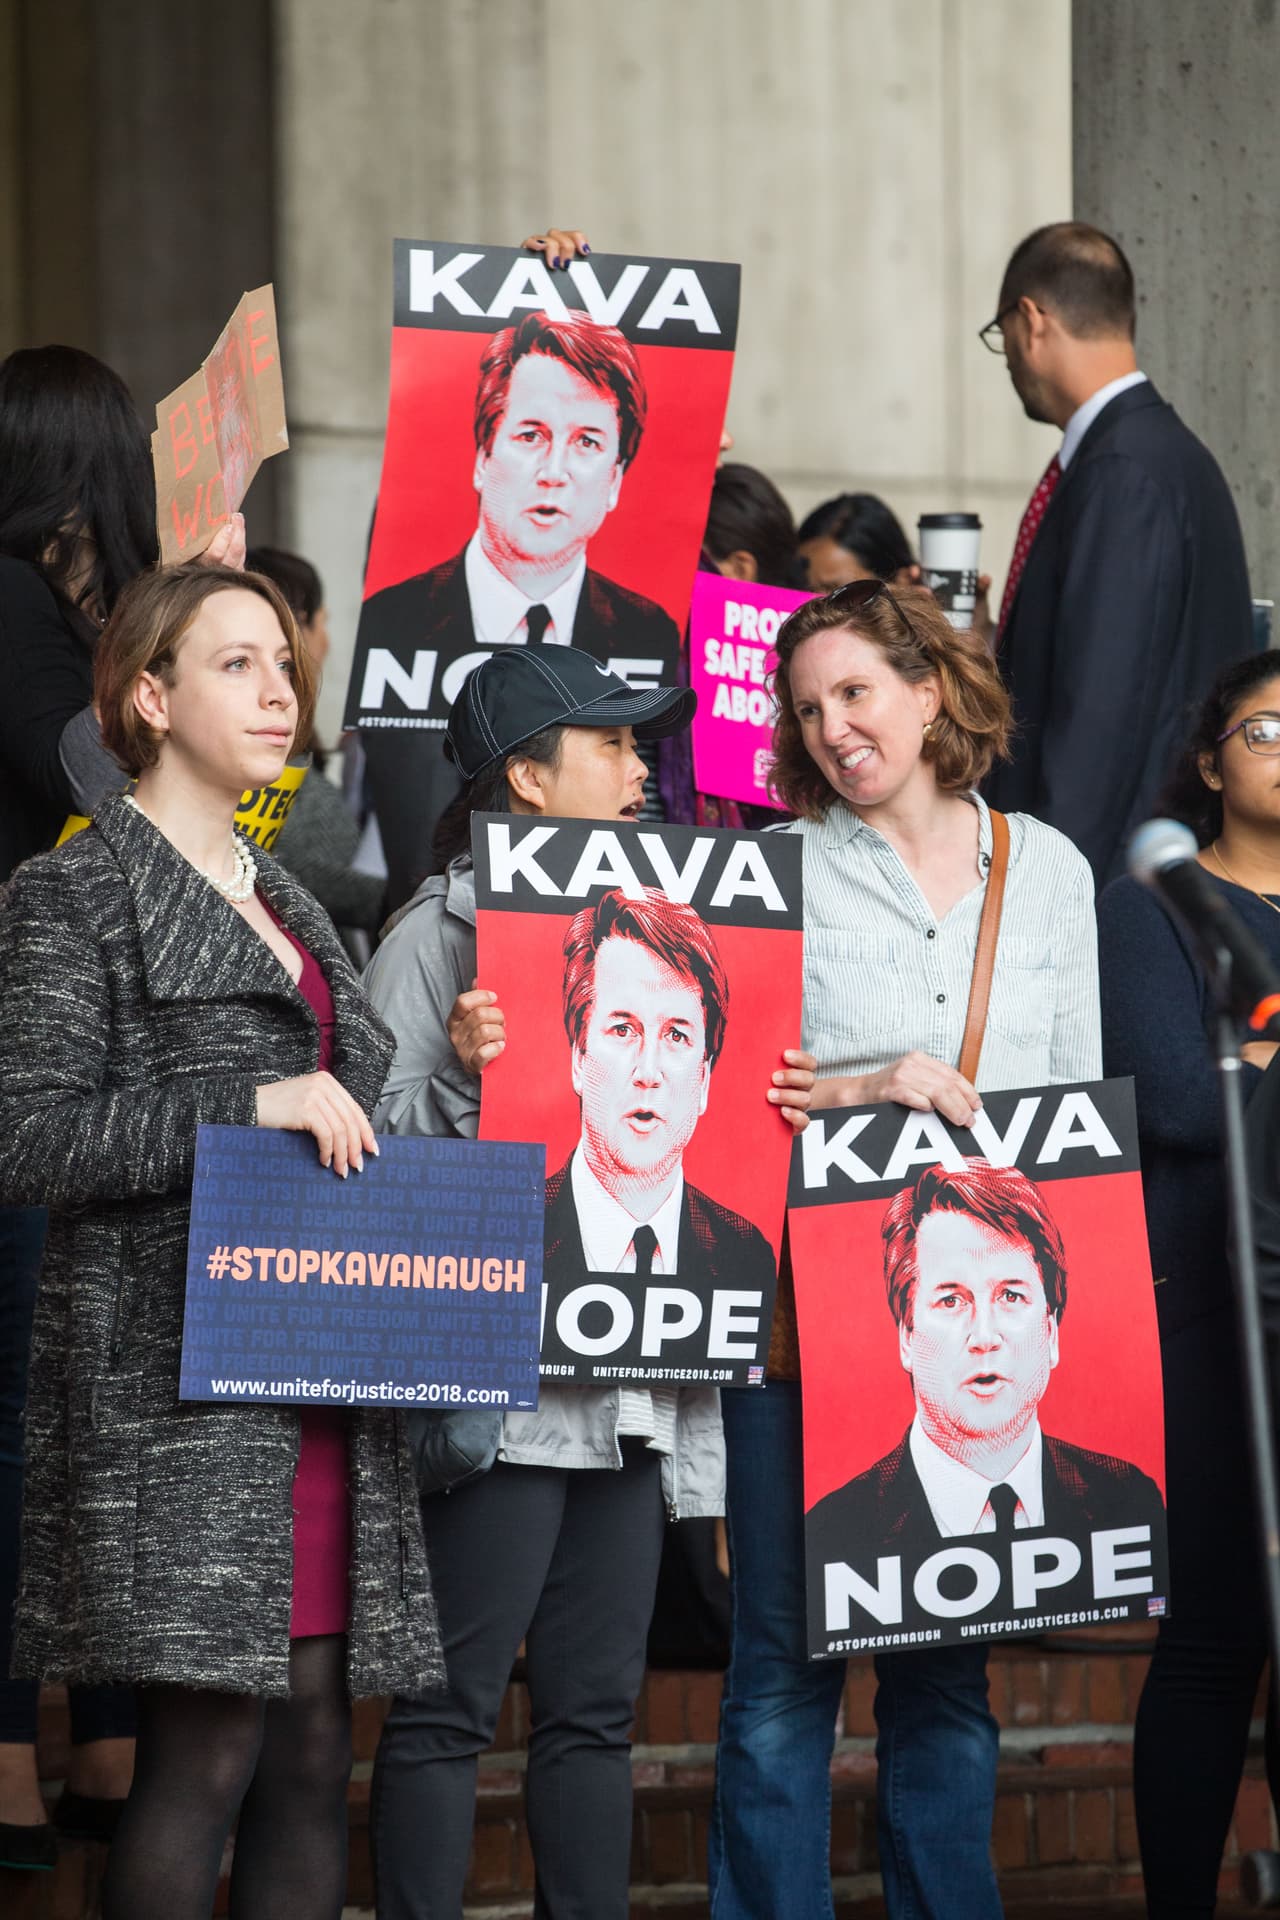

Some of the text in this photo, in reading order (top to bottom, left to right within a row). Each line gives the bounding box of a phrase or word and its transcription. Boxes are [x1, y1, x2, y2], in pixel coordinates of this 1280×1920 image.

[409, 249, 721, 334] KAVA
[704, 638, 766, 684] SAFE
[487, 822, 789, 912] KAVA
[801, 1091, 1123, 1189] KAVA
[206, 1245, 526, 1293] #STOPKAVANAUGH
[540, 1283, 763, 1360] OPE
[211, 1378, 510, 1404] www.uniteforjustice2018.com
[539, 1364, 576, 1376] NAUGH
[592, 1366, 734, 1381] UNITEFORJUSTICE2018.COM
[824, 1525, 1154, 1632] NOPE
[827, 1629, 942, 1652] #STOPKAVANAUGH
[960, 1606, 1129, 1637] UNITEFORJUSTICE2018.COM
